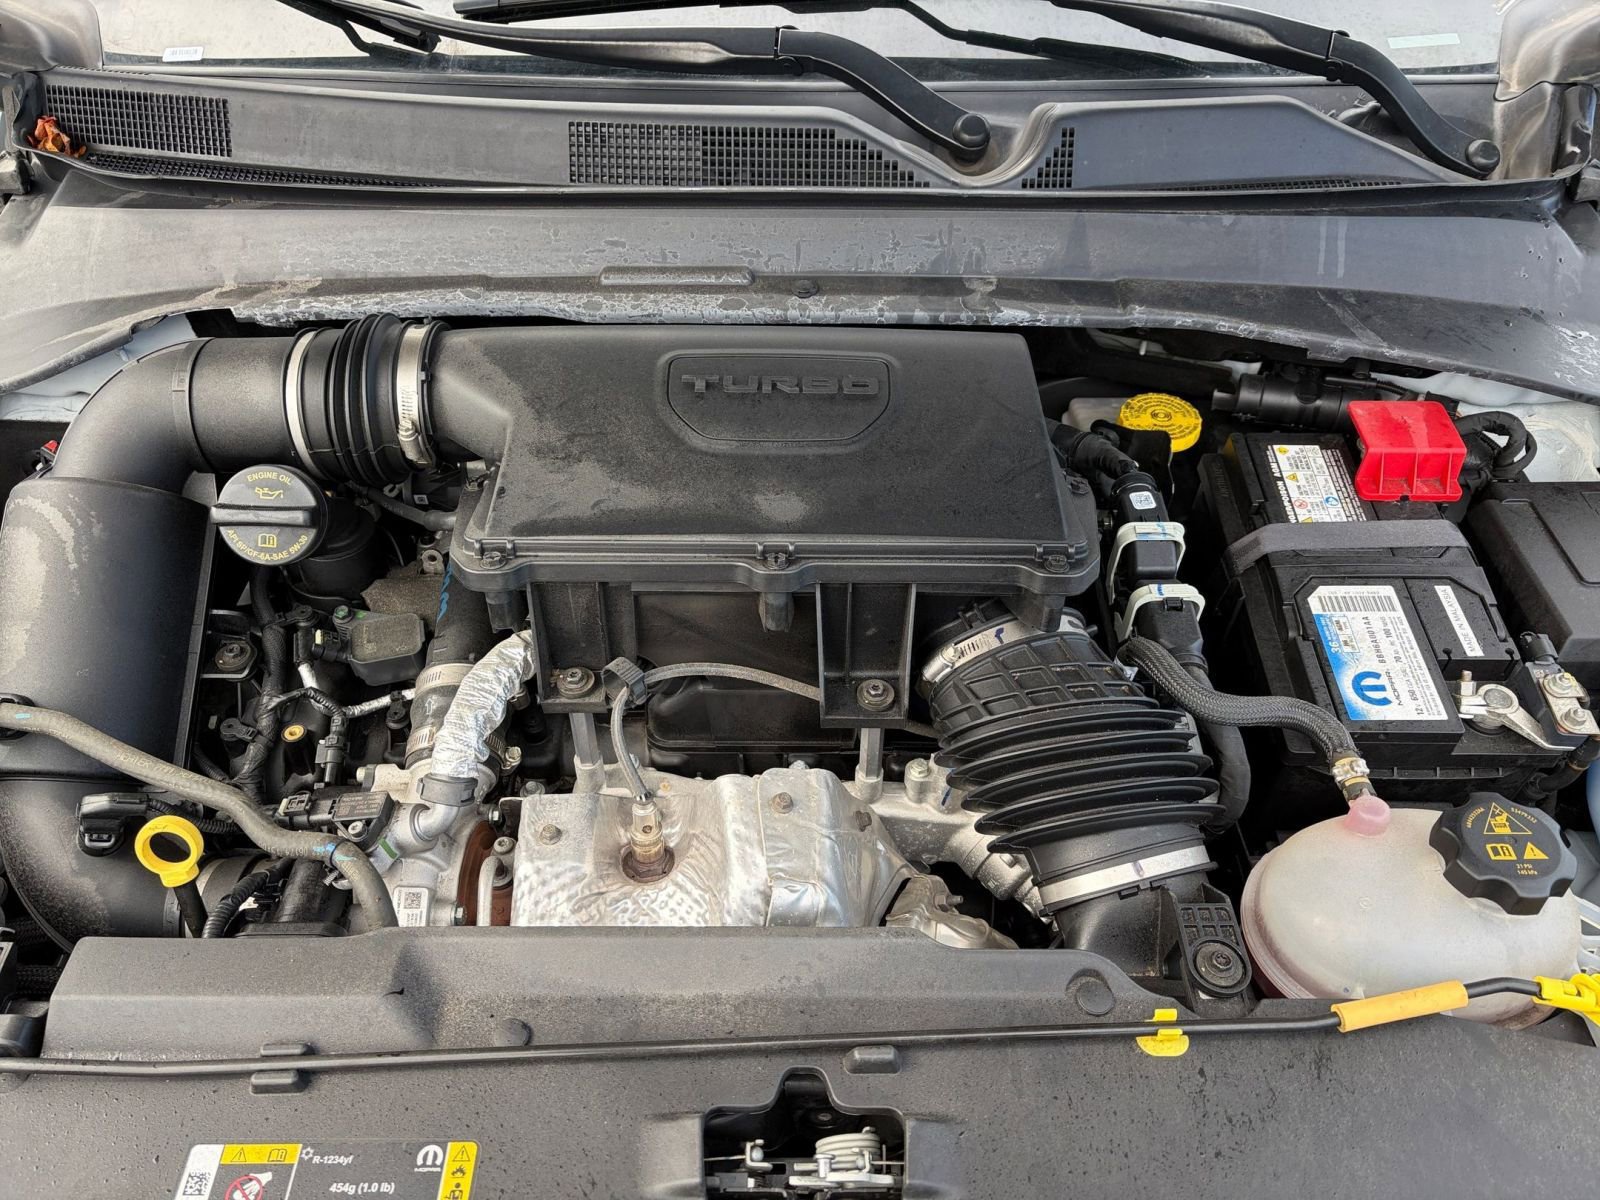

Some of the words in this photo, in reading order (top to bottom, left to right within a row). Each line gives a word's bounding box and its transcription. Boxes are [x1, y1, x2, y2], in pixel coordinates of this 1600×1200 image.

[681, 374, 879, 395] TURBO
[247, 471, 278, 482] ENGINE
[279, 475, 292, 485] OIL
[1270, 462, 1281, 478] AGM
[289, 534, 308, 554] 5W-30
[1441, 588, 1461, 622] MALAYSIA
[1457, 623, 1465, 631] IN
[1461, 632, 1475, 652] MADE
[1385, 671, 1403, 706] MOPAR
[312, 1155, 354, 1165] R-1234yf
[329, 1182, 356, 1195] 454g
[357, 1182, 379, 1194] (1.0
[380, 1182, 395, 1194] lb)
